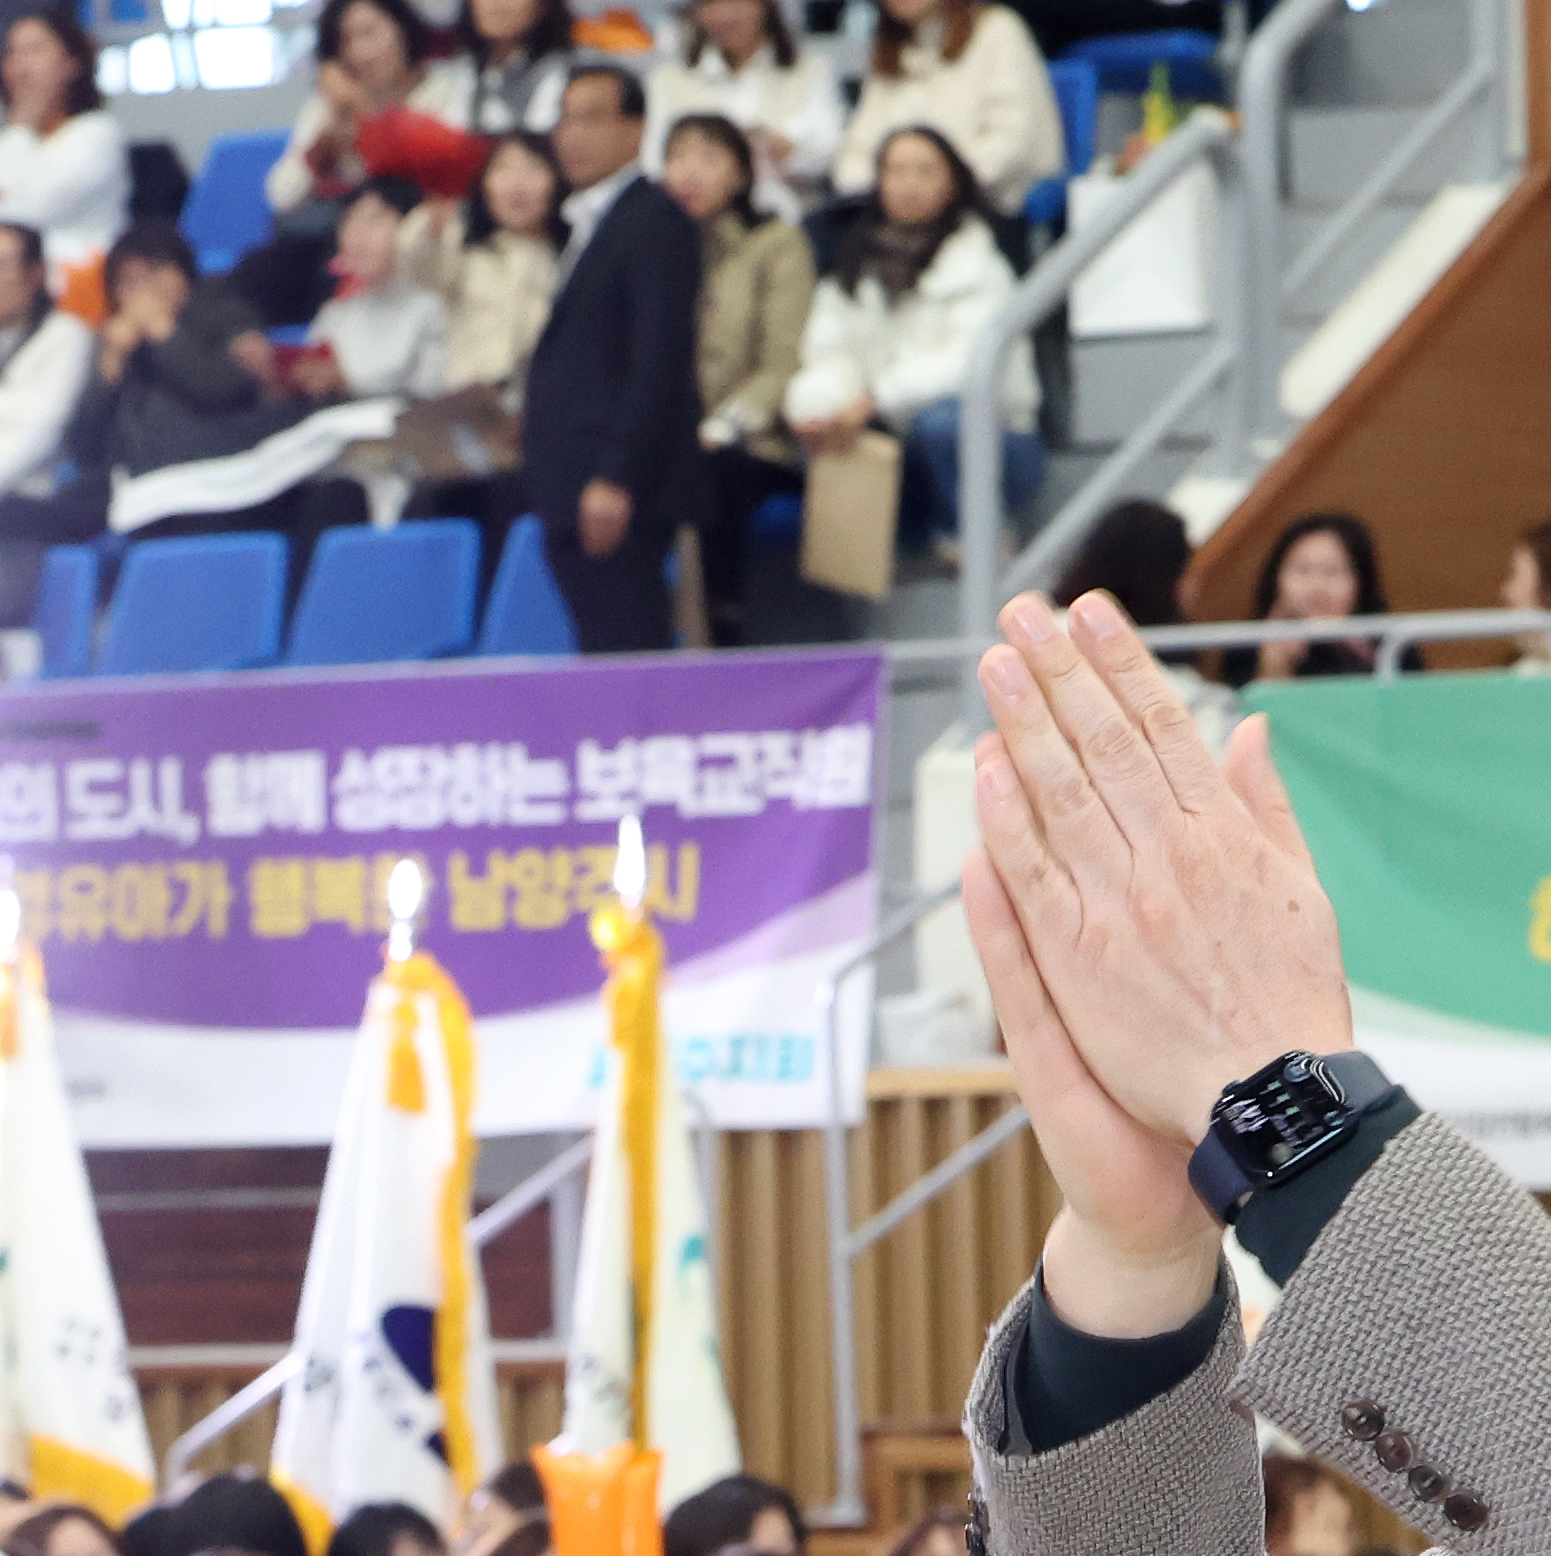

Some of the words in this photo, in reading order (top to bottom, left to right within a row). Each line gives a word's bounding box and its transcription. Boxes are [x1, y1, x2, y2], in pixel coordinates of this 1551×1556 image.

[62, 756, 201, 848] 도시,
[205, 750, 329, 838] 함께
[333, 742, 570, 832] 성장하는
[575, 721, 874, 822] 보육교직원
